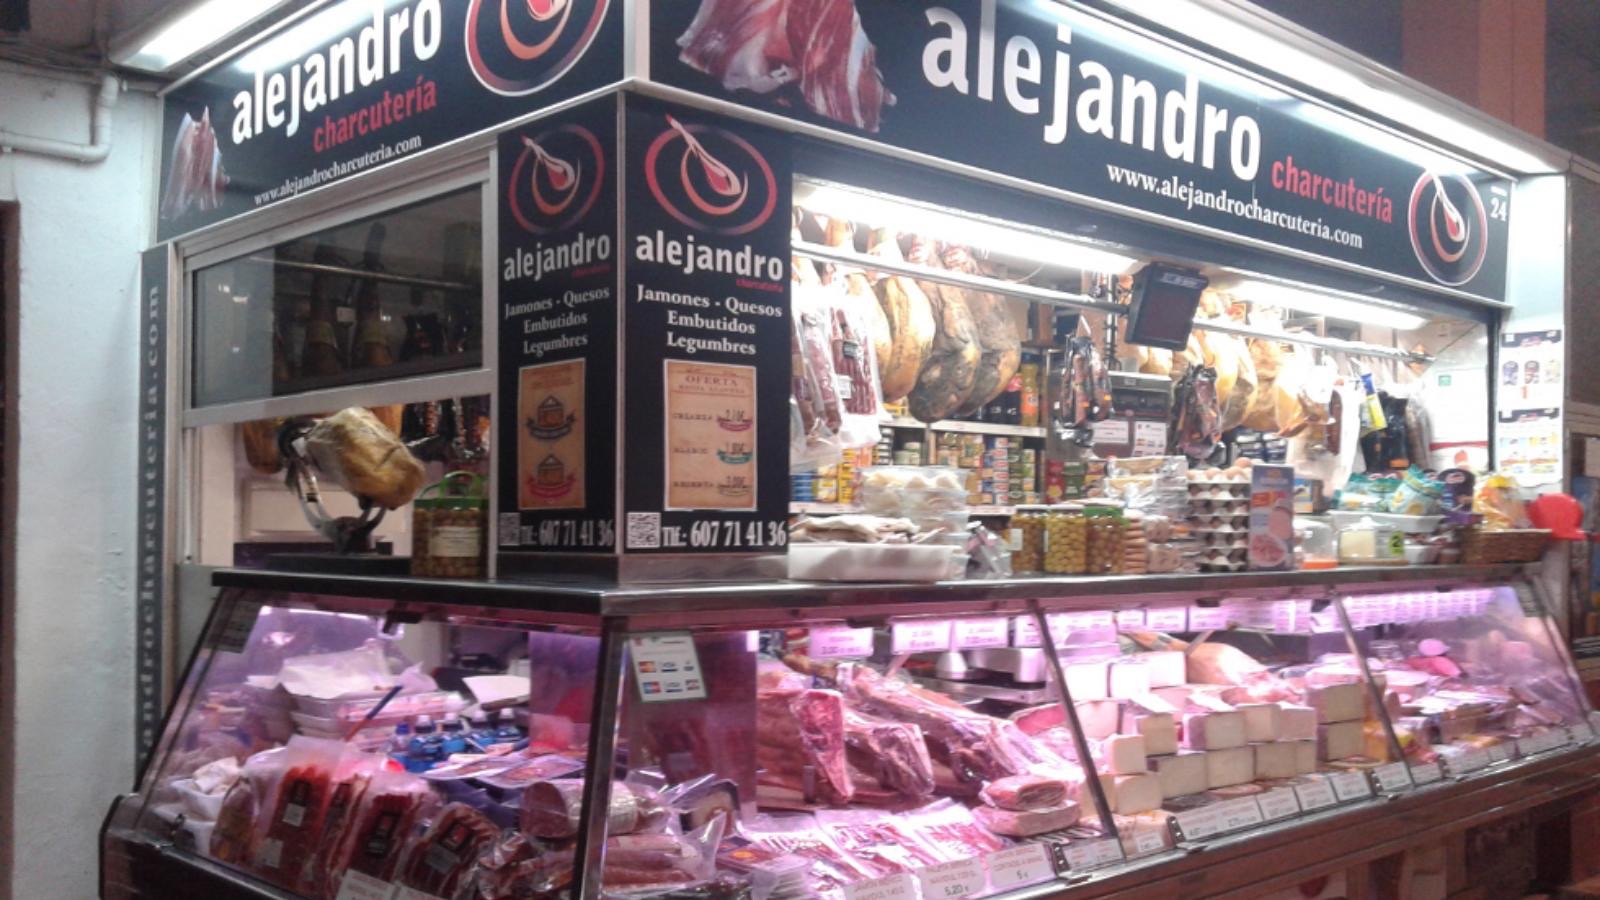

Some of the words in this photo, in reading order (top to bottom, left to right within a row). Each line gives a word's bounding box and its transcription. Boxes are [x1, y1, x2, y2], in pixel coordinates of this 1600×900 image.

[231, 0, 442, 145] alejandro
[922, 0, 1262, 181] alejandro
[313, 75, 437, 153] charcutería
[254, 135, 422, 206] www.alejandrocharcuteria.com
[1271, 154, 1393, 224] charcutería
[1106, 164, 1363, 250] www.alejandrocharcuteria.com
[1490, 196, 1507, 222] 24
[503, 232, 611, 281] alejandro
[635, 230, 784, 281] alejandro
[504, 299, 553, 320] Jamones
[563, 287, 610, 308] Quesos
[636, 284, 711, 308] Jamones
[725, 297, 783, 317] Quesos
[523, 312, 588, 334] Embutidos
[667, 310, 757, 334] Embutidos
[523, 334, 588, 358] Legumbres
[666, 332, 757, 355] Legumbres
[540, 519, 561, 546] 607
[563, 520, 577, 546] 71
[581, 520, 595, 546] 41
[598, 519, 615, 546] 36
[690, 519, 720, 547] 607
[724, 520, 742, 547] 71
[745, 520, 764, 546] 41
[767, 520, 787, 547] 36
